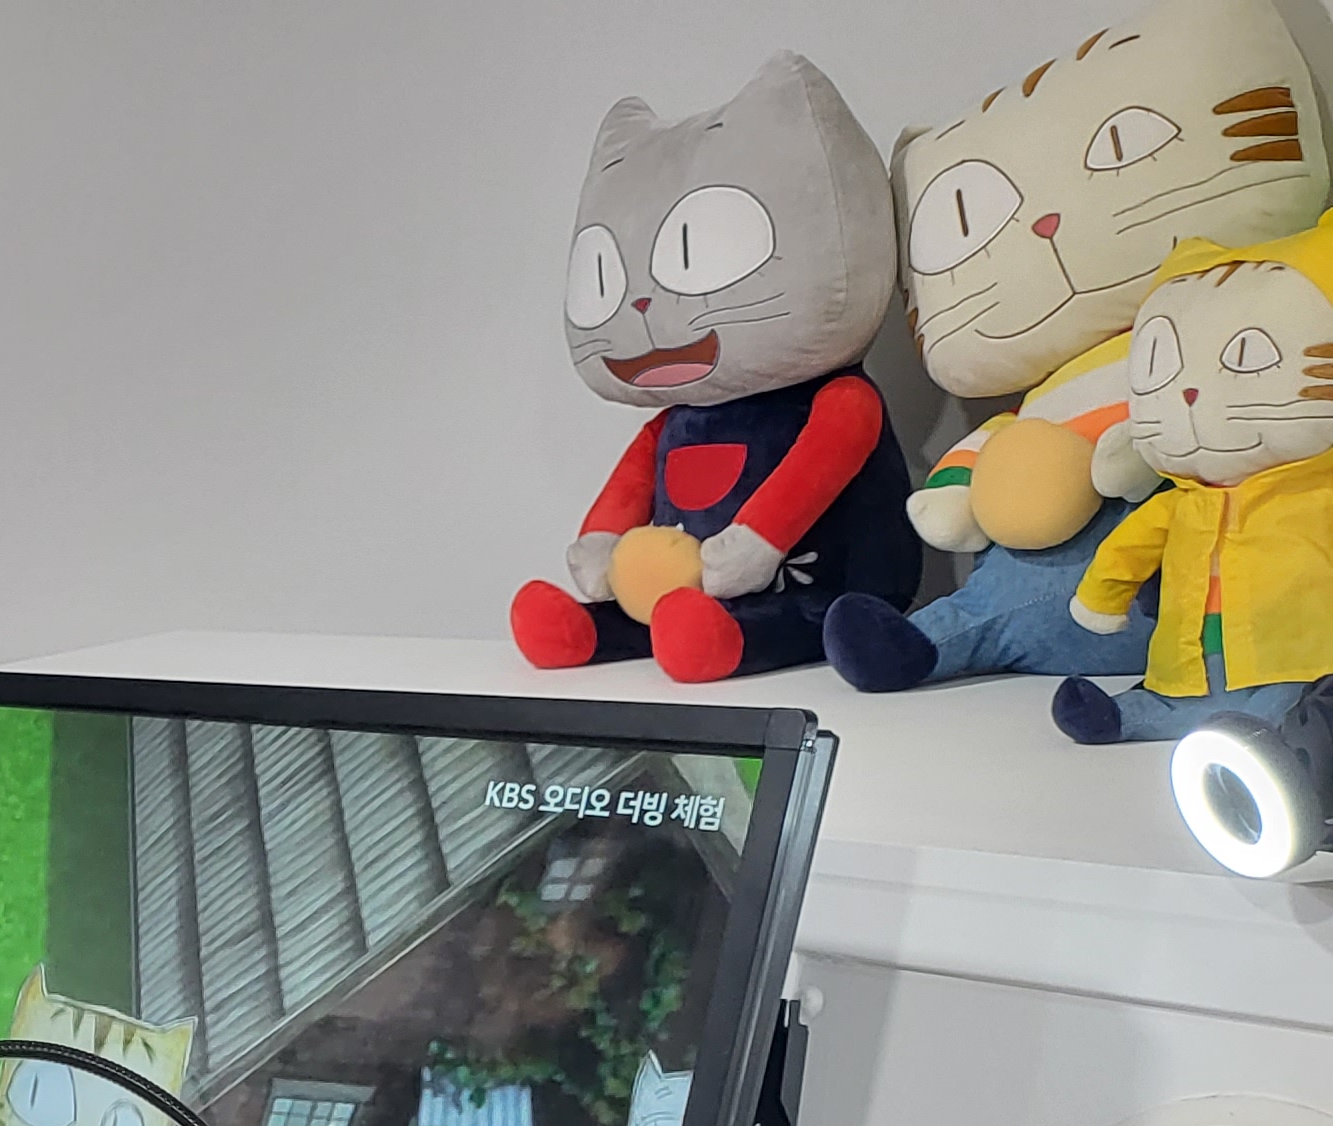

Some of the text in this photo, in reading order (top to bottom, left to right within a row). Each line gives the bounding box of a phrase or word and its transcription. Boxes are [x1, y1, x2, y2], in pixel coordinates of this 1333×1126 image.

[485, 780, 726, 831] KBS 오디오 더빙 체험
